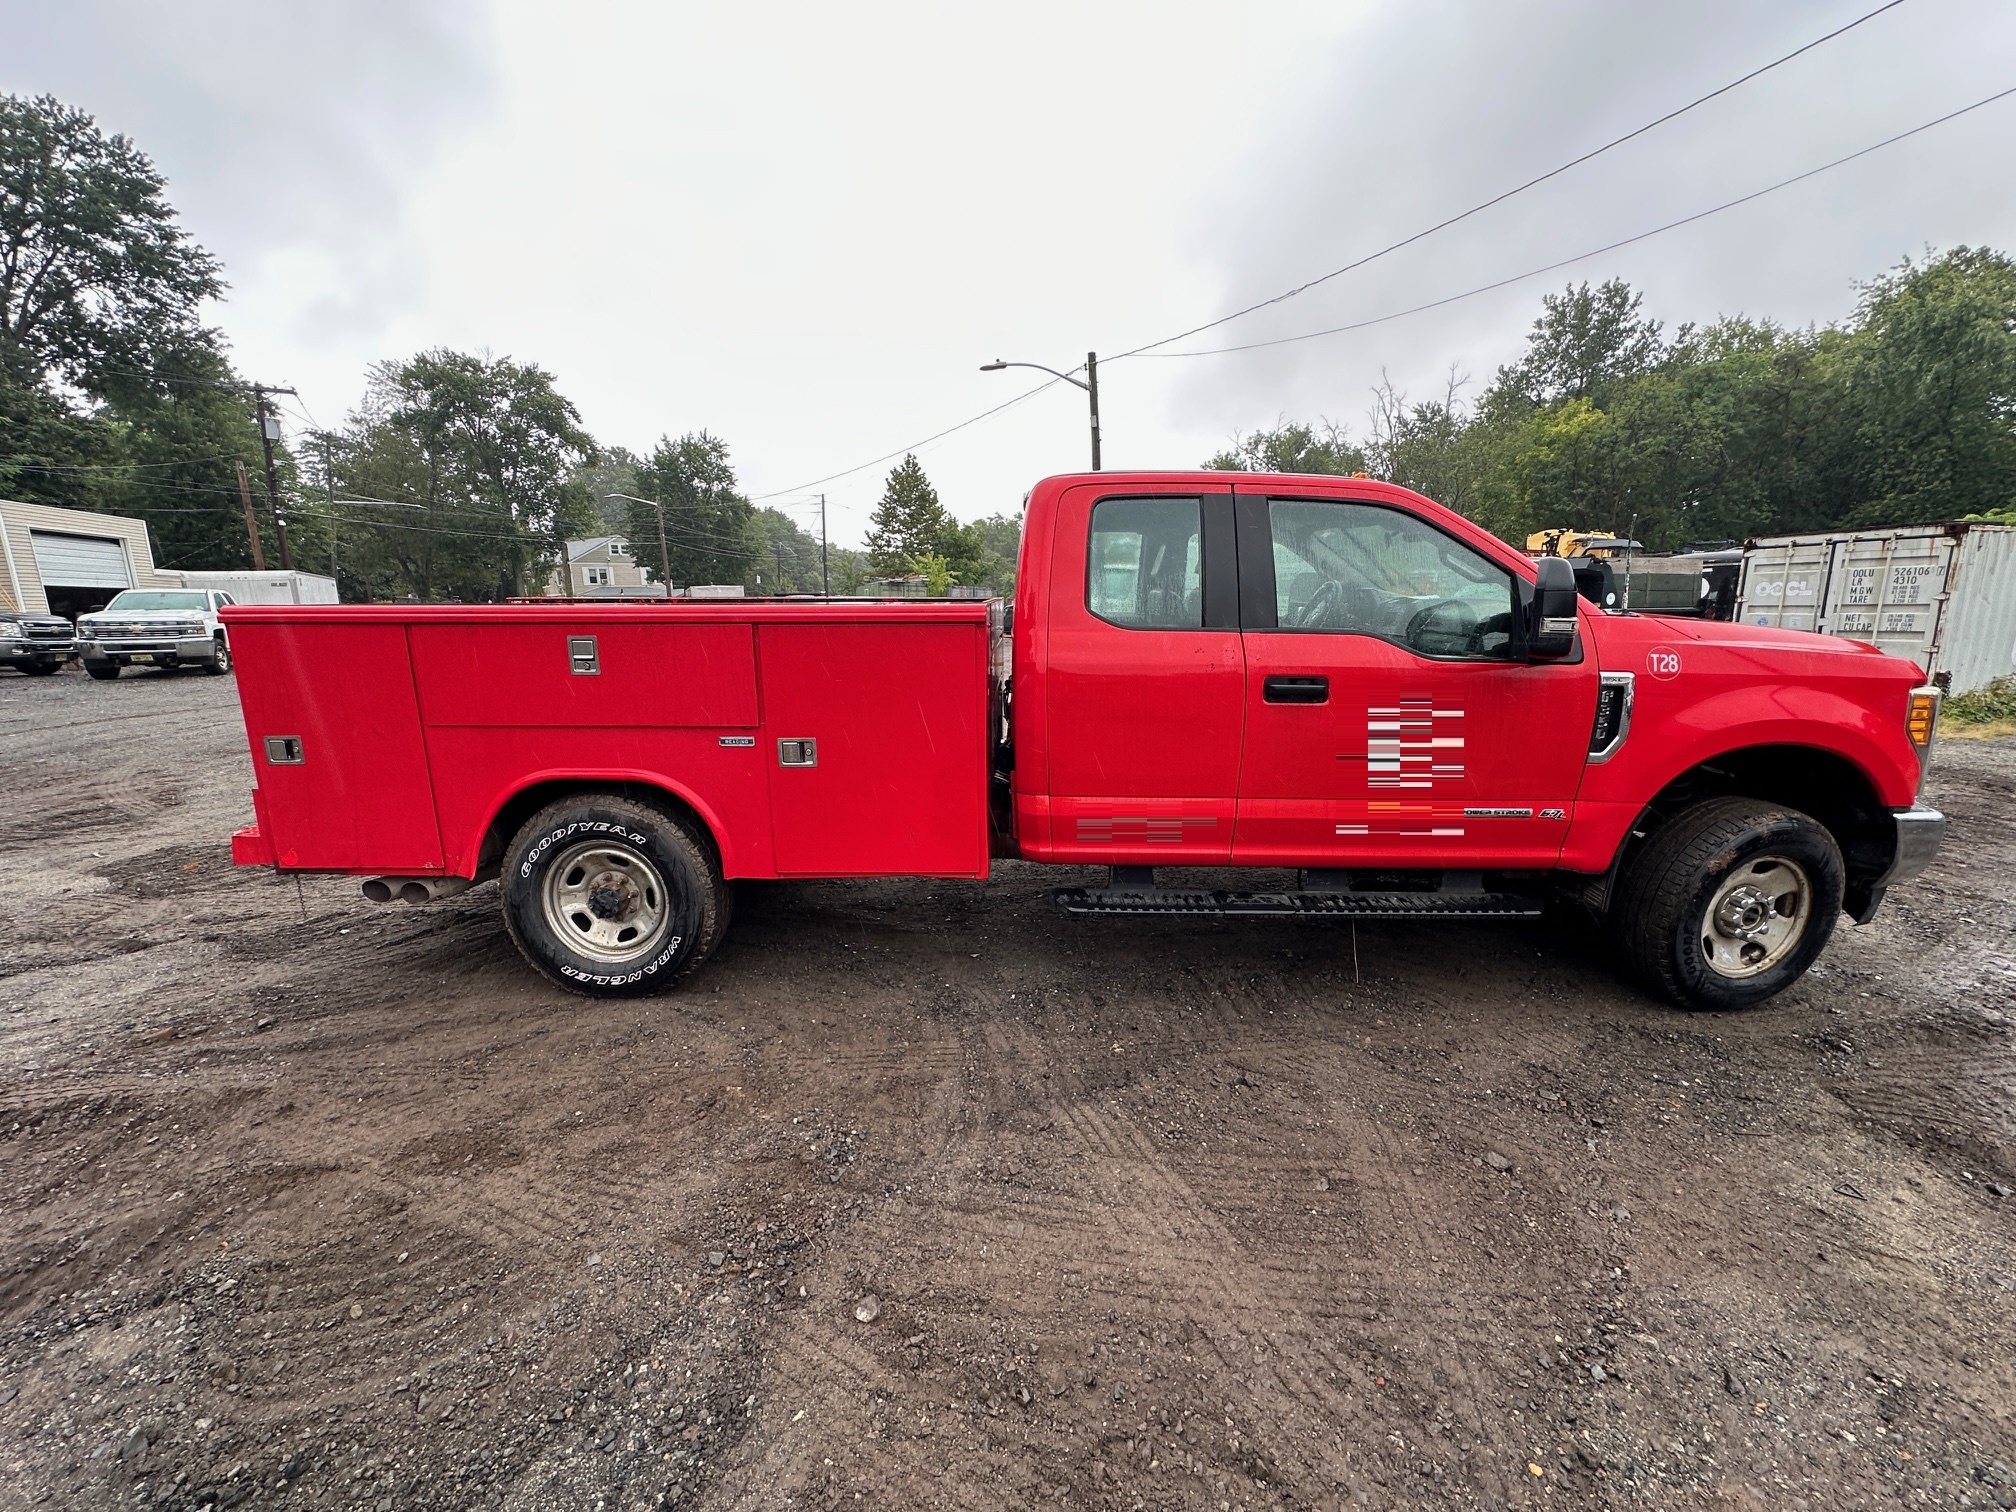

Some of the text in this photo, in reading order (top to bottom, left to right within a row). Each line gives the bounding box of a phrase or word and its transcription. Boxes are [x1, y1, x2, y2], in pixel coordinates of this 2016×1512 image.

[1852, 569, 1875, 578] OOLU
[1894, 567, 1930, 576] 526106
[1851, 576, 1917, 586] LR 4310
[1755, 581, 1812, 596] OOCL
[1849, 595, 1868, 604] TARE
[1845, 614, 1862, 622] NET
[1650, 653, 1679, 673] T28
[521, 821, 647, 878] GOODYEAR
[560, 935, 682, 985] WRANGLER
